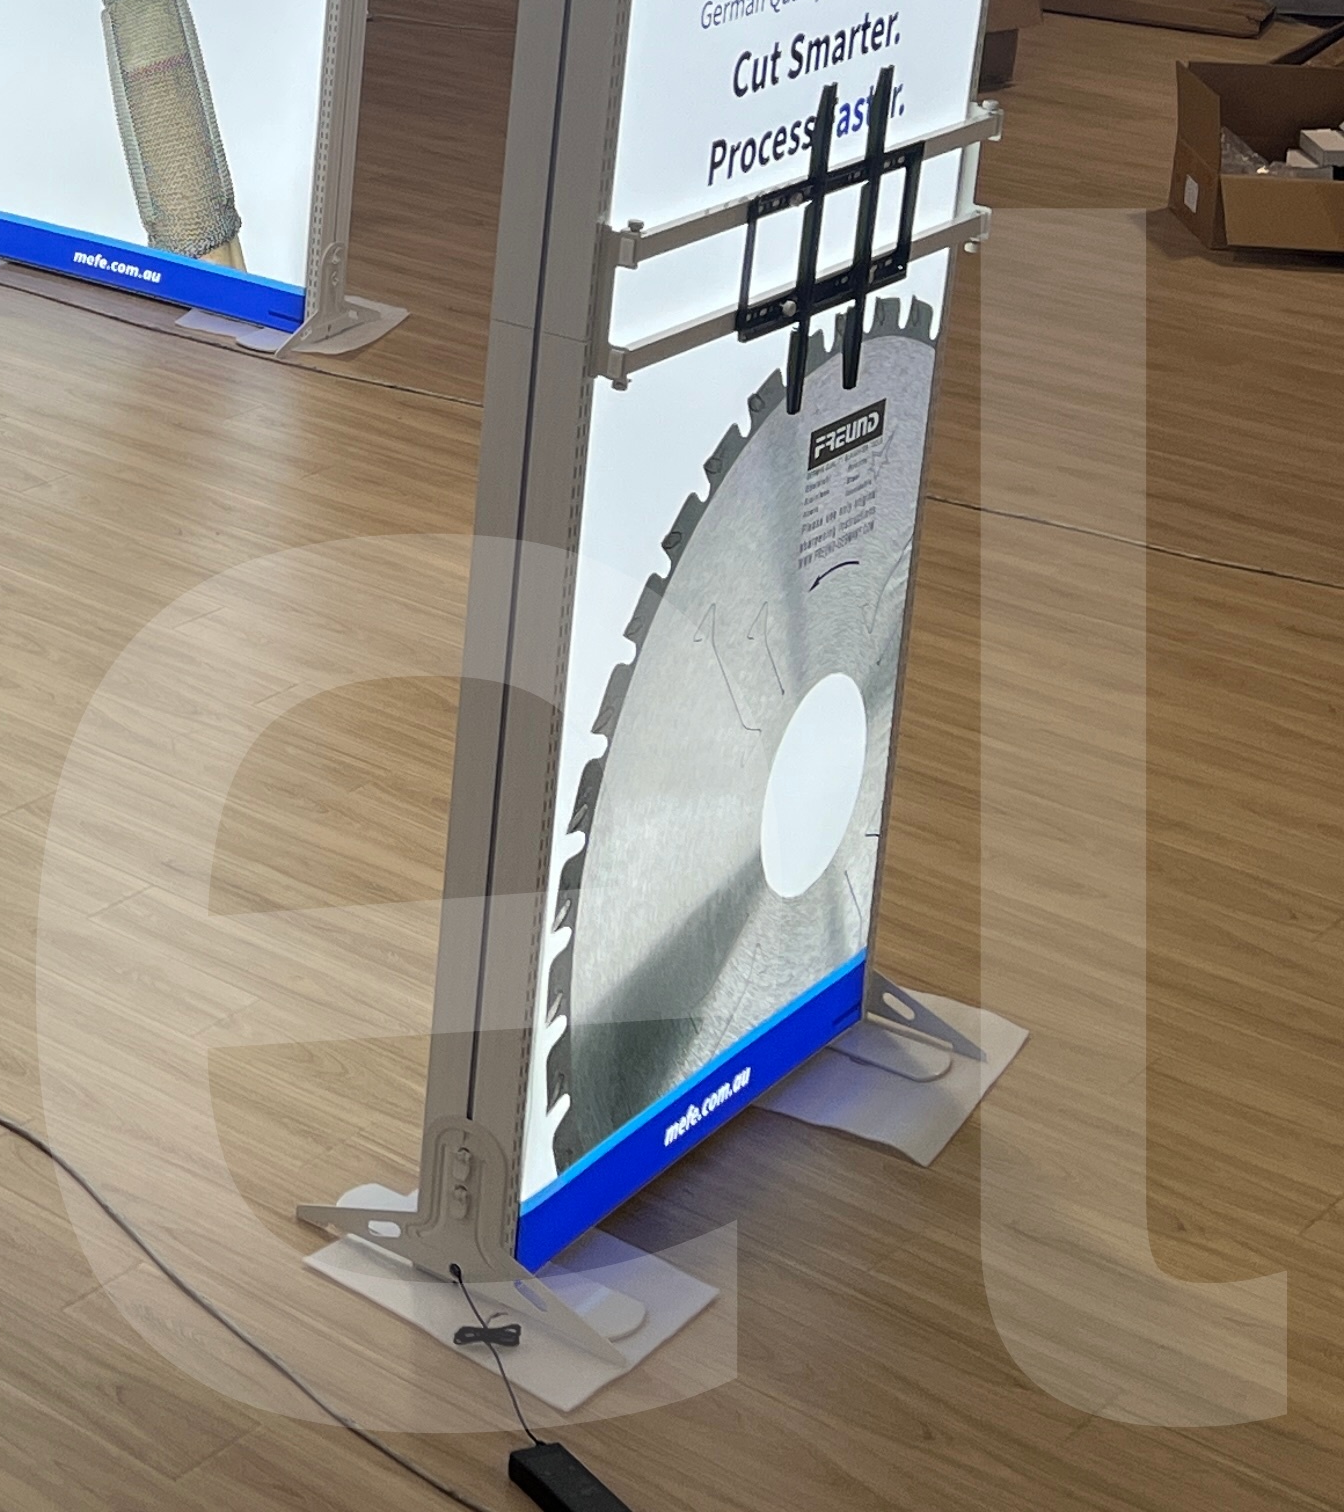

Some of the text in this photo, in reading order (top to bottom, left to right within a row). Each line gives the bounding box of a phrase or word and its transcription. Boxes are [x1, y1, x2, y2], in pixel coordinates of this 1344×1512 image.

[732, 11, 901, 98] Cut Smarter.
[707, 114, 817, 187] Process
[73, 251, 162, 284] mefe.com.au
[814, 411, 880, 460] FREUND
[664, 1066, 752, 1147] mefe.com.au
